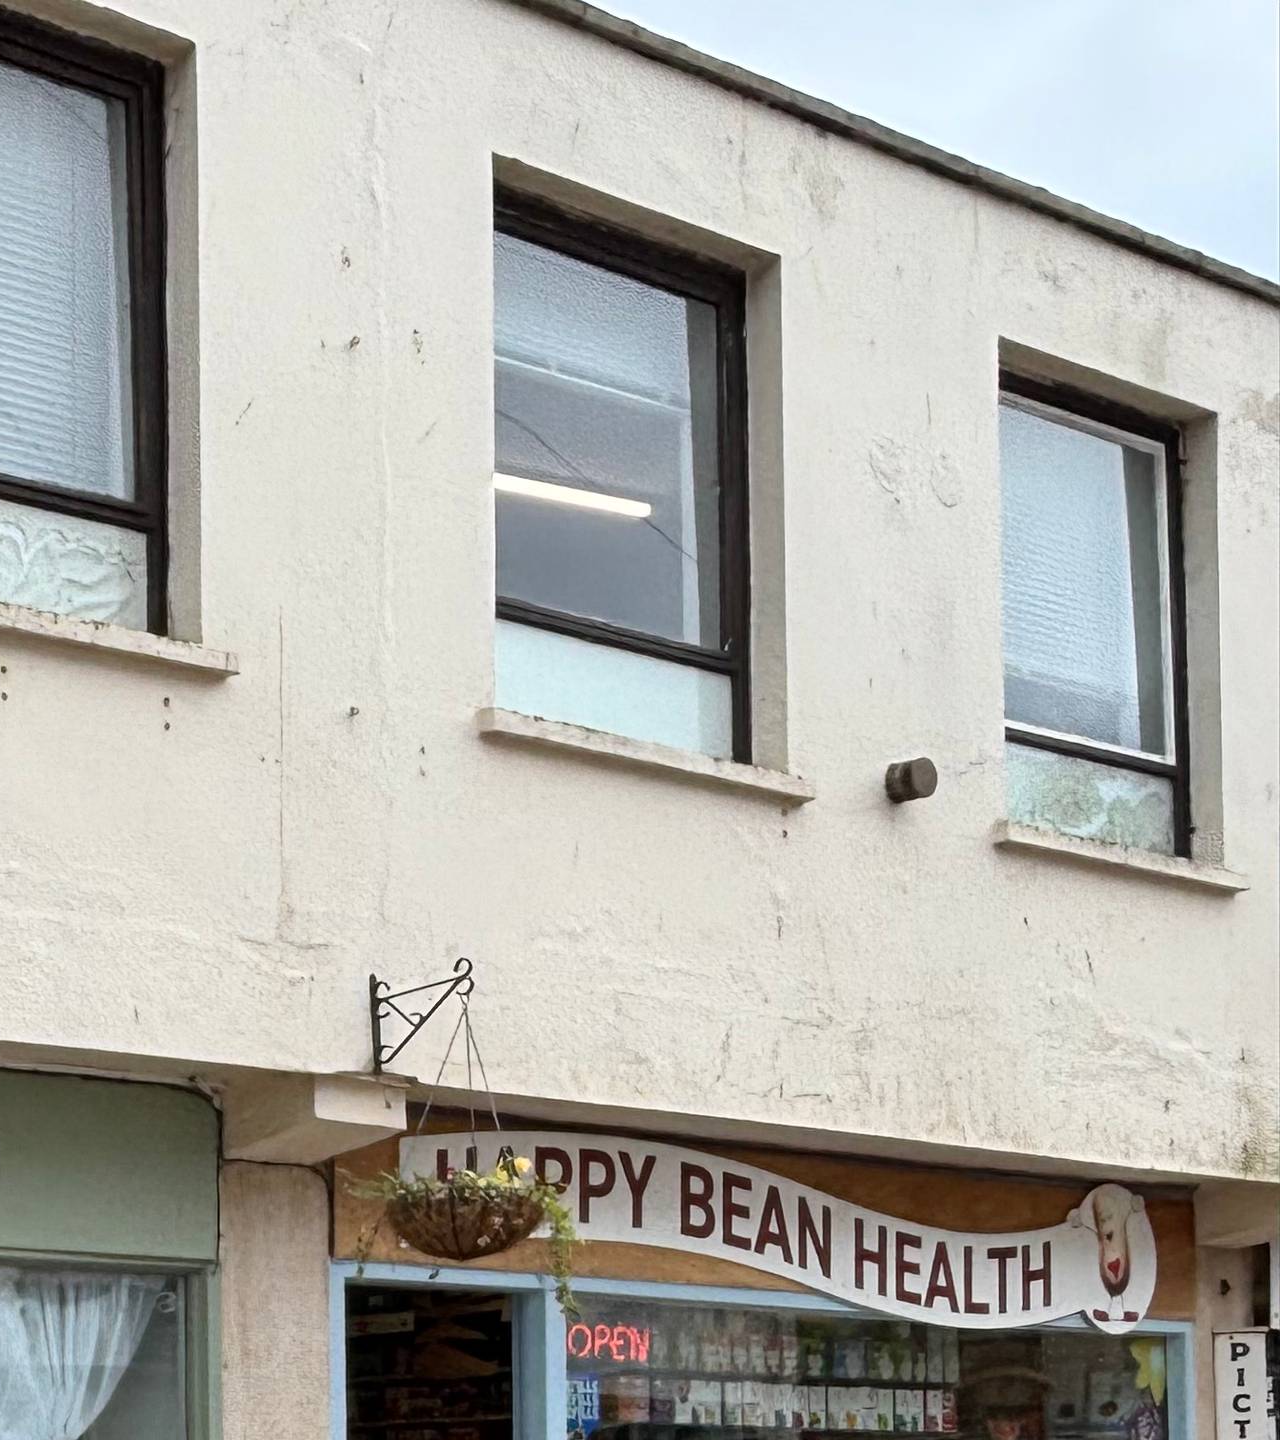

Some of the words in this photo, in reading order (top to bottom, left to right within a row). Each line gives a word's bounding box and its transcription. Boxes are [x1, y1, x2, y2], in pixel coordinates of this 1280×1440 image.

[680, 1161, 831, 1279] BEAN
[854, 1217, 1052, 1314] HEALTH
[568, 1323, 649, 1362] OPEN
